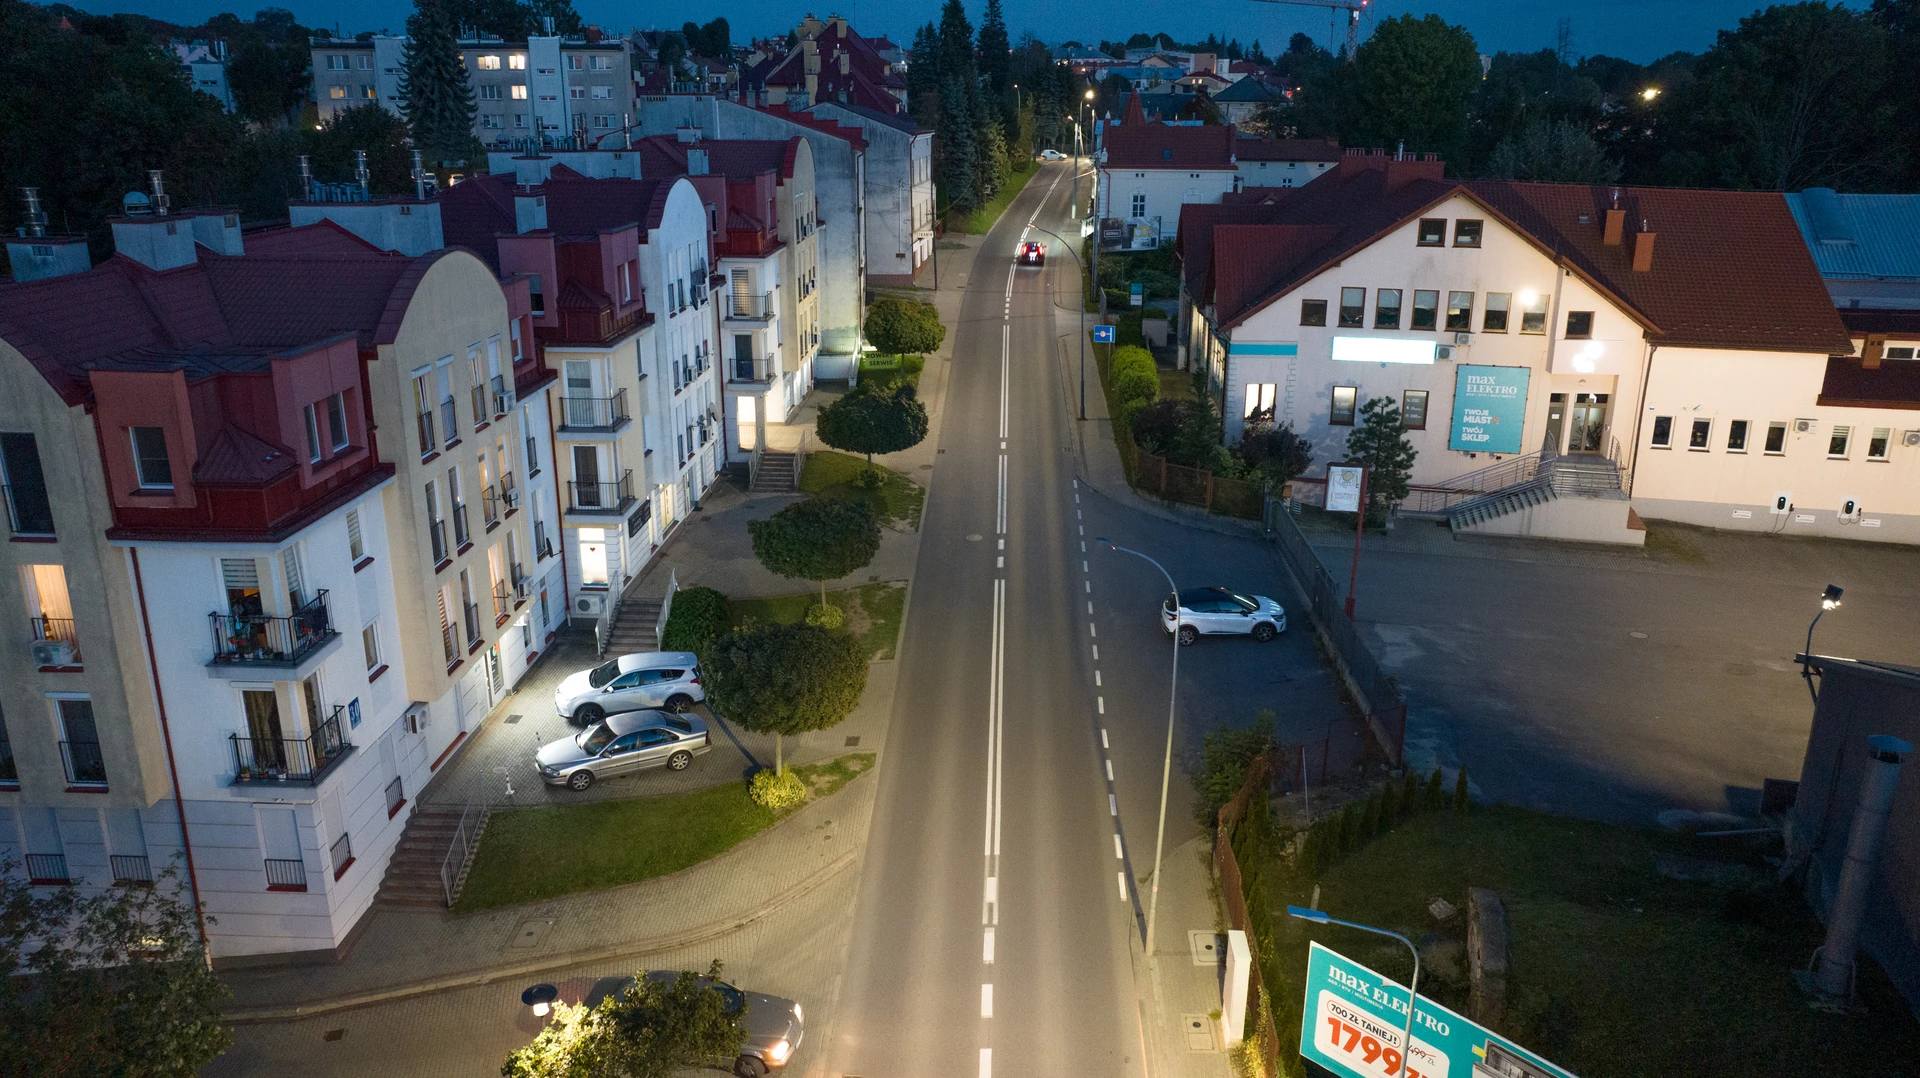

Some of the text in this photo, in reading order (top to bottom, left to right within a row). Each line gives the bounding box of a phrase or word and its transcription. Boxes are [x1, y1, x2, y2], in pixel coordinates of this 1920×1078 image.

[1466, 384, 1517, 394] ELEKTRO
[1467, 375, 1496, 385] max
[350, 701, 360, 720] 30
[1328, 964, 1450, 1036] max ELEKTRO
[1354, 992, 1384, 1010] MULTIMEDIA
[1331, 1003, 1348, 1018] 700
[1349, 1013, 1359, 1025] ZŁ
[1327, 1016, 1403, 1077] 1799
